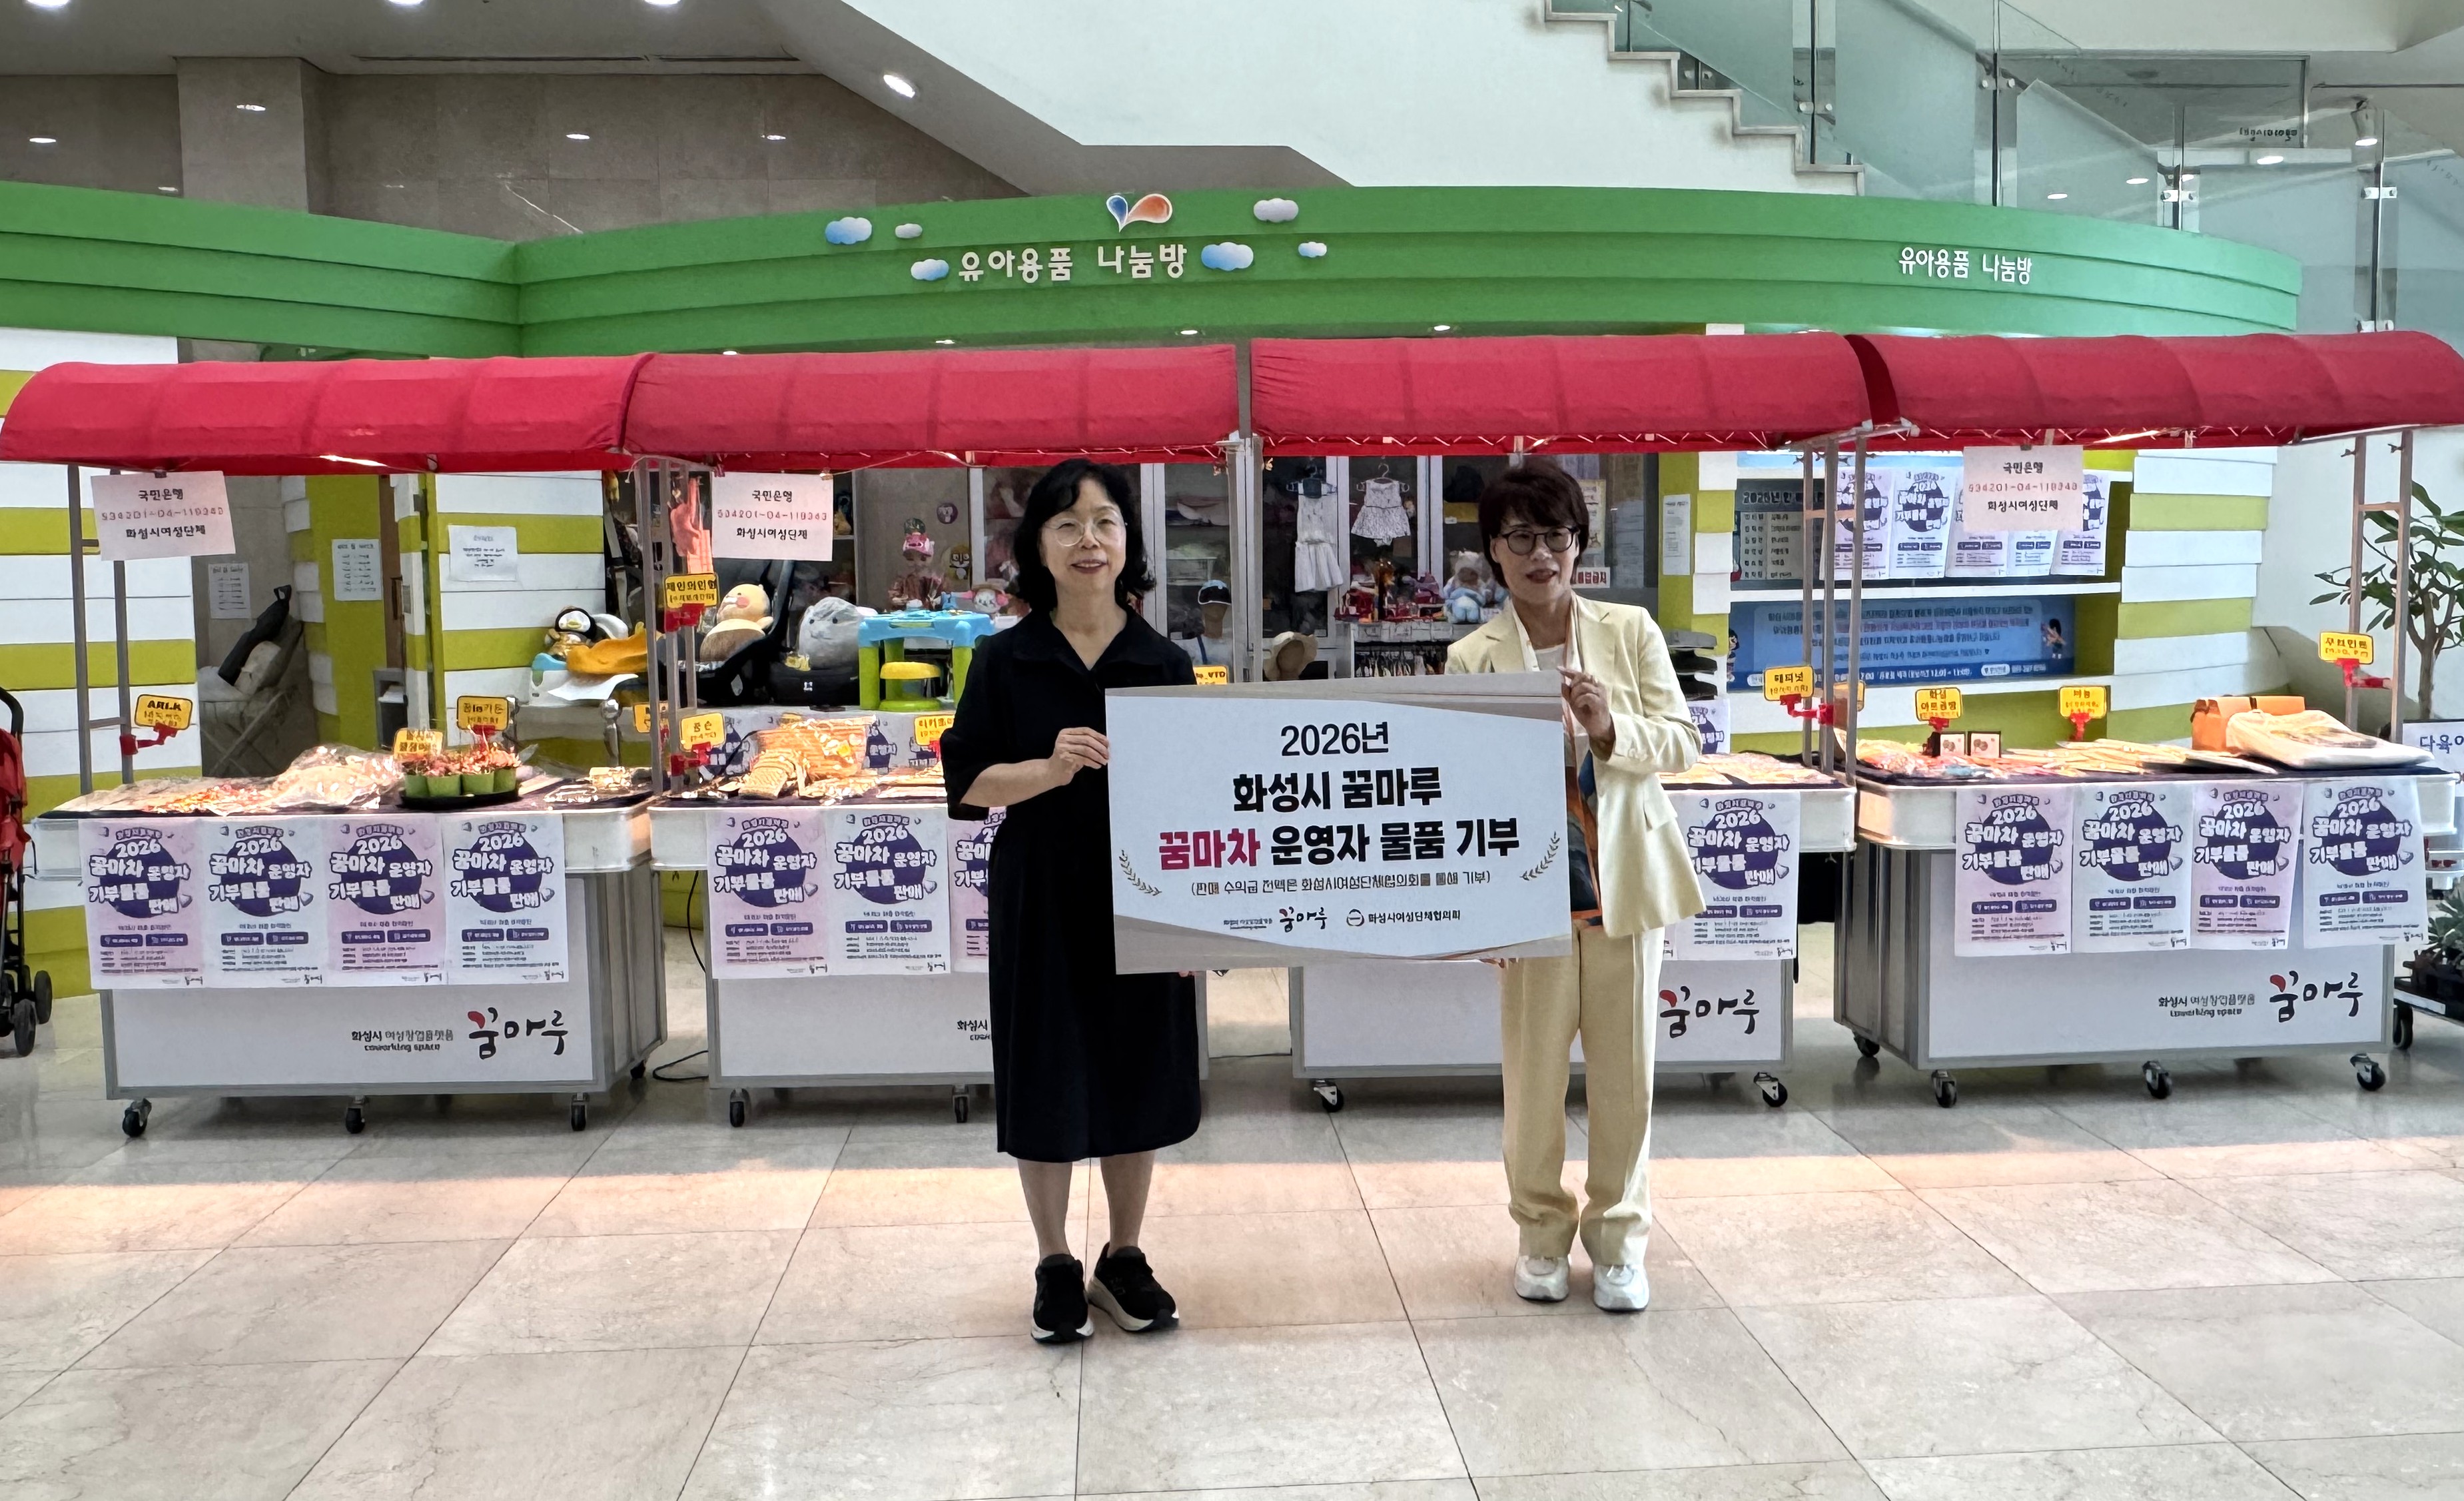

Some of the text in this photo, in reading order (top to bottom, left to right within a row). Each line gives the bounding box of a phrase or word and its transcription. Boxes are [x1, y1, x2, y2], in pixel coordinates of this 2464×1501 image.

[958, 244, 1188, 283] 유아용품 나눔방
[1898, 247, 2032, 284] 유아용품 나눔방
[1280, 722, 1390, 757] 2026년
[1232, 767, 1442, 813] 화성시 꿈마루
[1992, 805, 2037, 825] 2026
[2109, 801, 2153, 821] 2026
[2222, 801, 2265, 819] 2026
[2338, 797, 2381, 817] 2026
[1715, 809, 1761, 829] 2026
[2083, 819, 2136, 841] 꿈마차
[2199, 815, 2247, 839] 꿈마차
[2313, 815, 2363, 837] 꿈마차
[479, 833, 524, 852] 2026
[741, 828, 787, 848] 2026
[861, 825, 908, 845] 2026
[1158, 817, 1520, 871] 꿈마차 운영자 물품 기부
[1687, 826, 1742, 849] 꿈마차
[1965, 822, 2018, 844] 꿈마차
[115, 838, 161, 857] 2026
[235, 836, 282, 856] 2026
[356, 834, 404, 855] 2026
[835, 841, 891, 865] 꿈마차
[210, 853, 264, 876] 꿈마차
[330, 852, 386, 875] 꿈마차
[453, 850, 506, 872] 꿈마차
[715, 844, 769, 868] 꿈마차
[1224, 880, 1258, 895] 수익금
[1462, 870, 1491, 885] 기부)
[2269, 970, 2363, 1023] 꿈마루
[1659, 985, 1760, 1039] 꿈마루
[467, 1007, 568, 1060] 꿈마루
